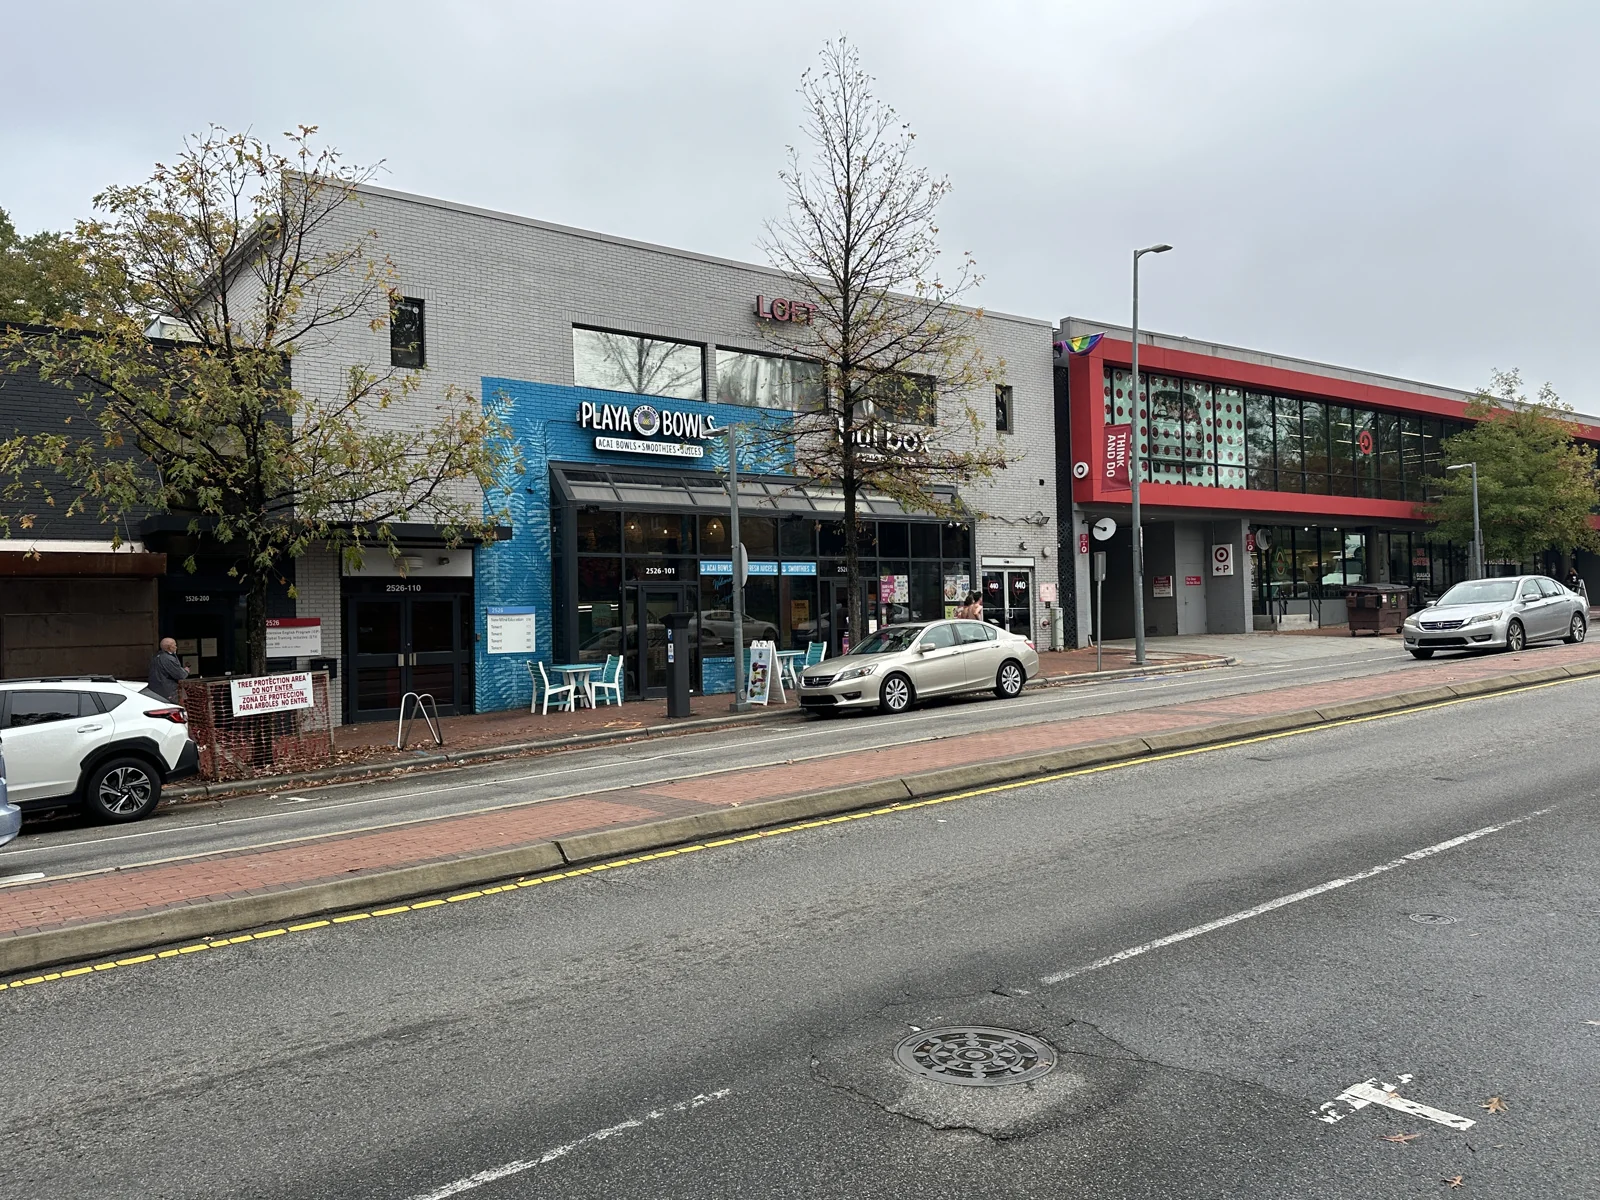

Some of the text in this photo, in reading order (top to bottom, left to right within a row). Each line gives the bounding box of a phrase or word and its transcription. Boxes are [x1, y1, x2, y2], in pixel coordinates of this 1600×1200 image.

[757, 295, 819, 326] LOFT
[581, 401, 633, 432] PLAYA
[662, 410, 716, 440] BOWLS
[886, 421, 931, 454] box
[598, 439, 702, 456] ACAI BOWLS SMOOTHIES JUICES
[1116, 432, 1126, 468] THINK
[1106, 434, 1116, 478] AND DO
[645, 567, 675, 575] 2526-101
[706, 564, 732, 572] ACAI BOWLS
[760, 565, 773, 573] JUICES
[787, 565, 810, 573] SMOOTHIES
[1223, 565, 1229, 573] P
[386, 584, 422, 592] 2526-110
[1015, 581, 1026, 589] 440
[237, 681, 252, 689] TREE
[254, 677, 290, 687] PROTECTION
[274, 683, 293, 692] ENTER
[242, 696, 258, 704] ZONA
[268, 690, 304, 700] PROTECCION
[239, 703, 253, 711] PARA
[254, 700, 279, 709] ARBOLES
[290, 697, 308, 705] ENTRE
